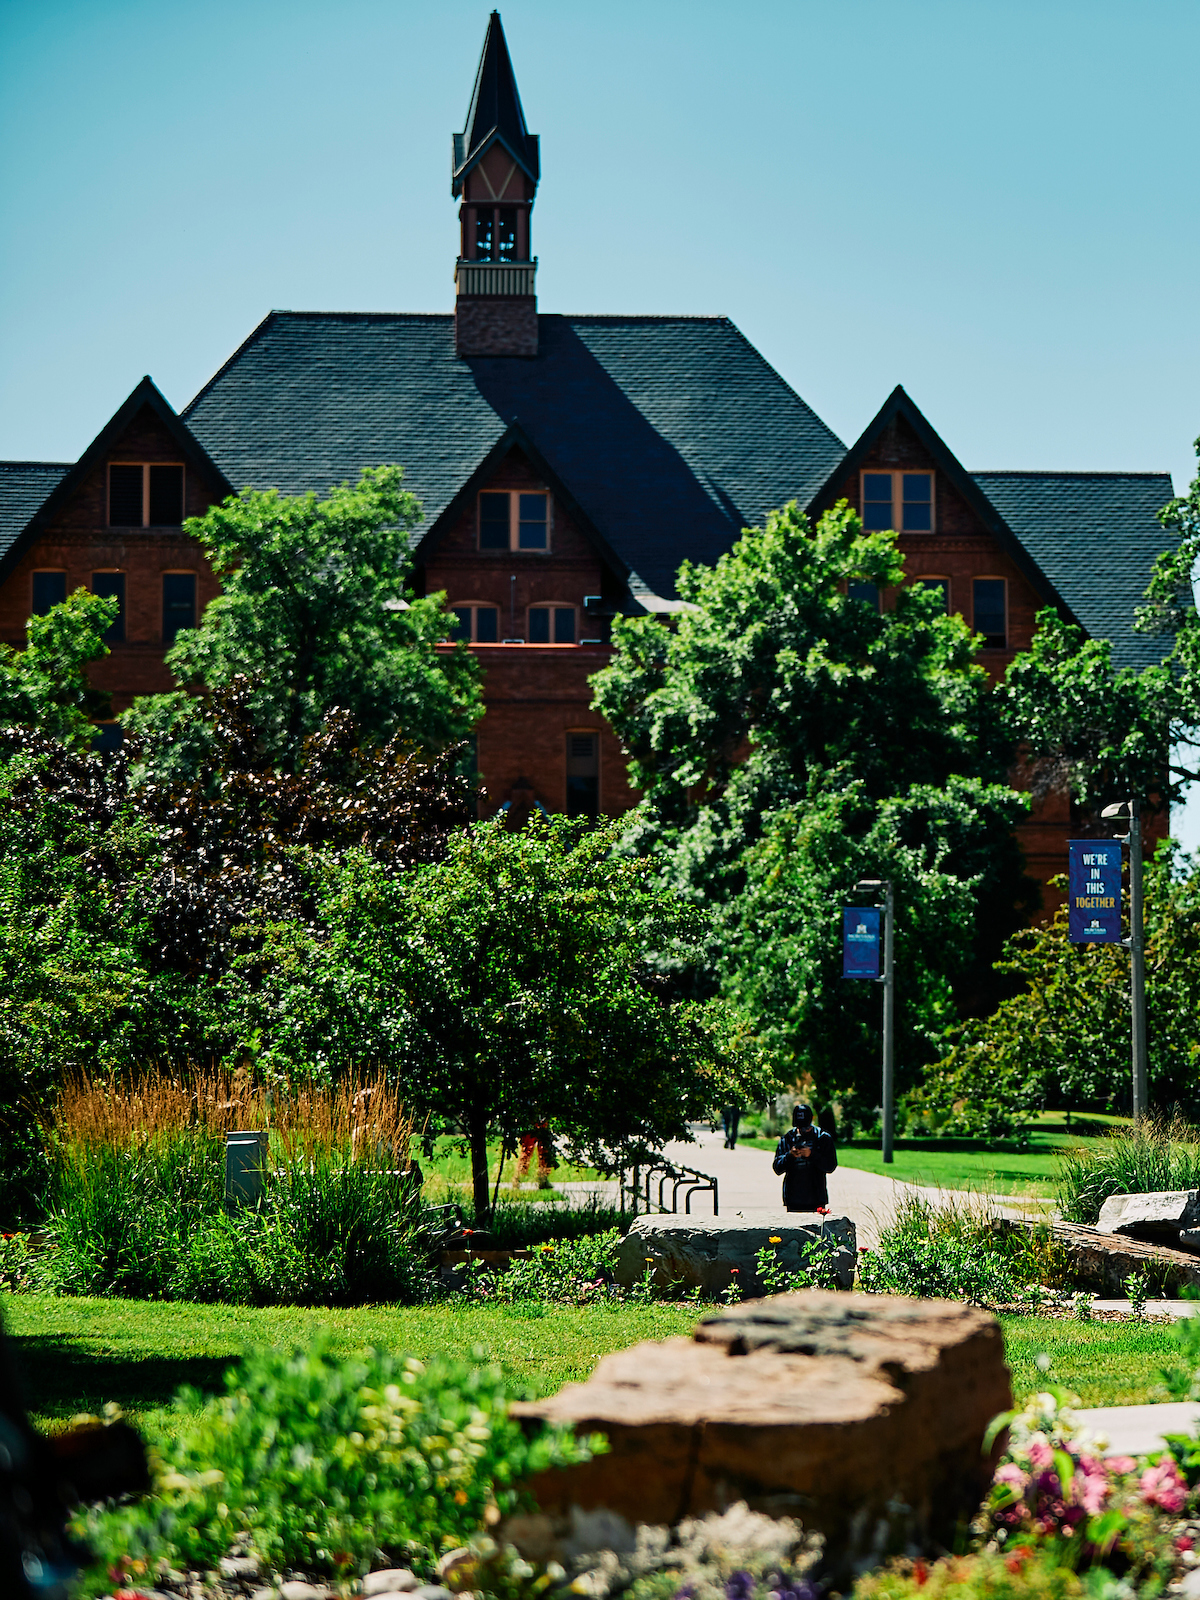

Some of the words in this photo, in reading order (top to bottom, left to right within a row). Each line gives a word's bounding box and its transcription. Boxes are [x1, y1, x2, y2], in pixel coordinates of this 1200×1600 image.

[1083, 854, 1108, 865] WE'RE
[1091, 869, 1100, 879] IN
[1086, 883, 1105, 894] THIS
[1076, 897, 1115, 908] TOGETHER
